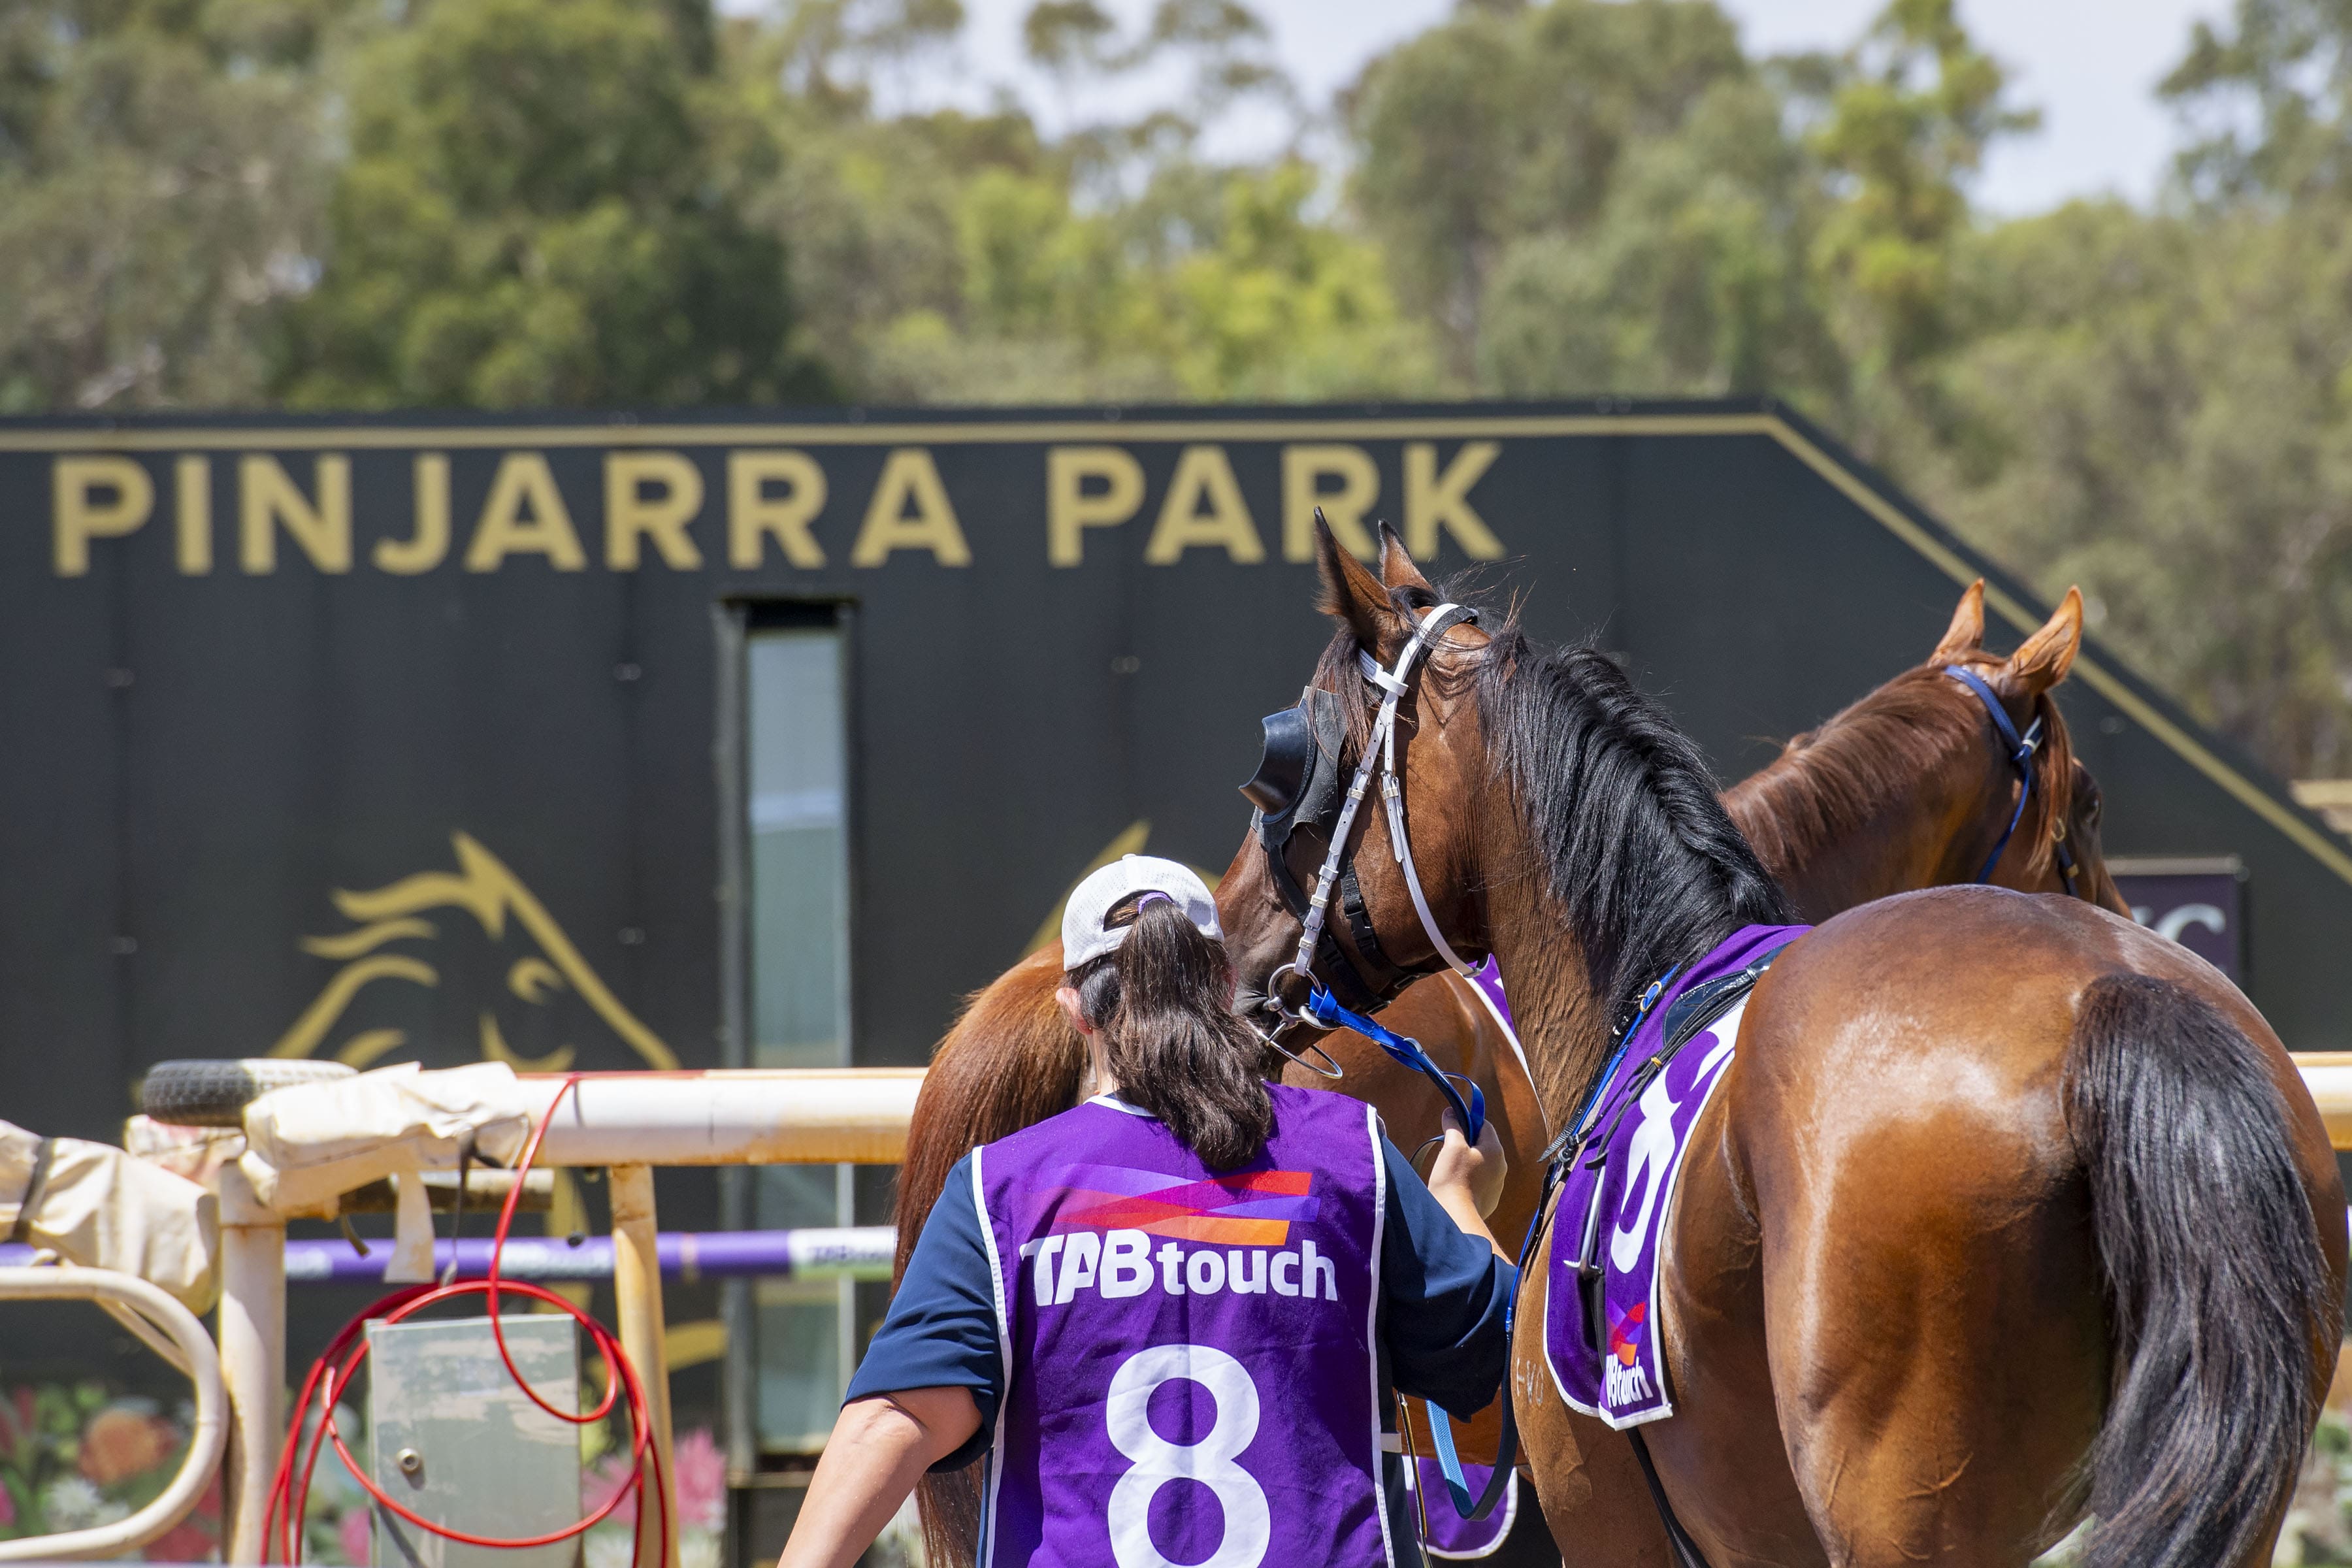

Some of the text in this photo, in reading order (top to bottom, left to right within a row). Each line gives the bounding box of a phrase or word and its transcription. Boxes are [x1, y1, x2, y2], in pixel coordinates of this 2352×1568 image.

[52, 442, 1507, 576] PINJARRA PARK
[1019, 1228, 1338, 1307] TABtouch
[1105, 1343, 1271, 1568] 8
